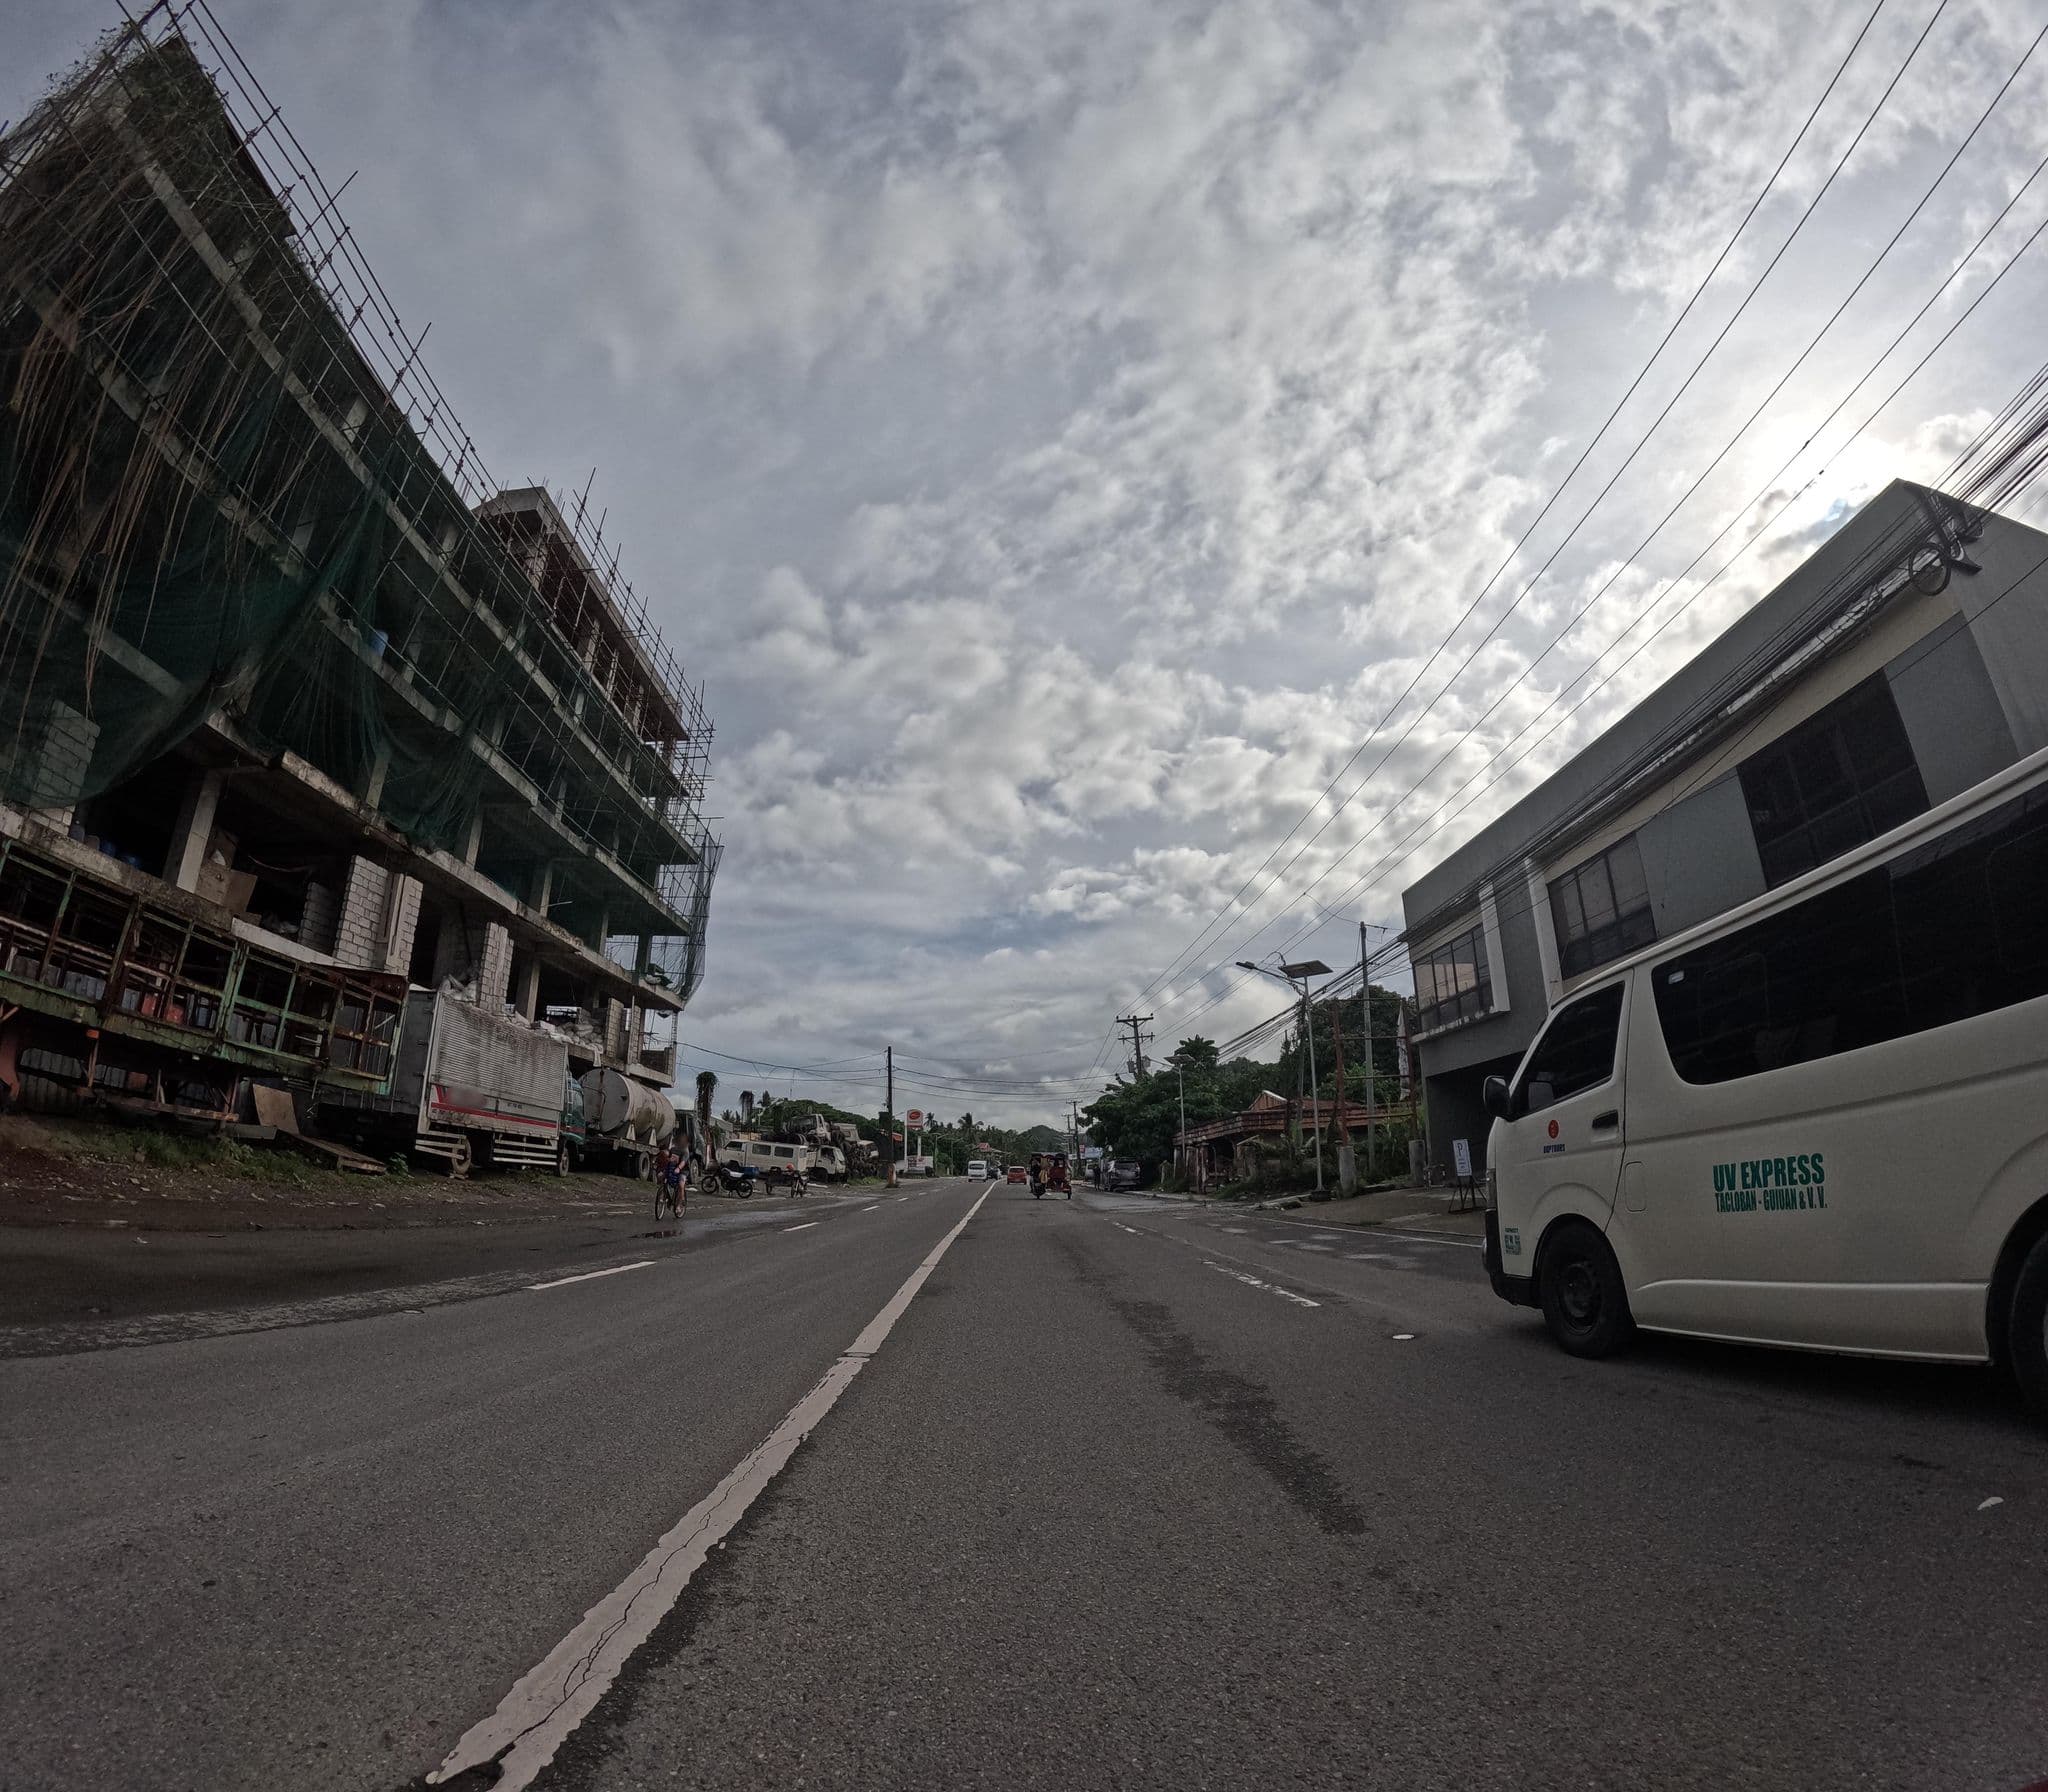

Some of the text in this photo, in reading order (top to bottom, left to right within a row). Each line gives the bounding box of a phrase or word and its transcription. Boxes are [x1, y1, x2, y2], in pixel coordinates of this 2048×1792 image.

[1712, 1153, 1825, 1192] UV EXPRESS
[1715, 1190, 1757, 1213] TACLOBAN
[1763, 1188, 1798, 1211] GUIUAN
[1799, 1190, 1806, 1210] &
